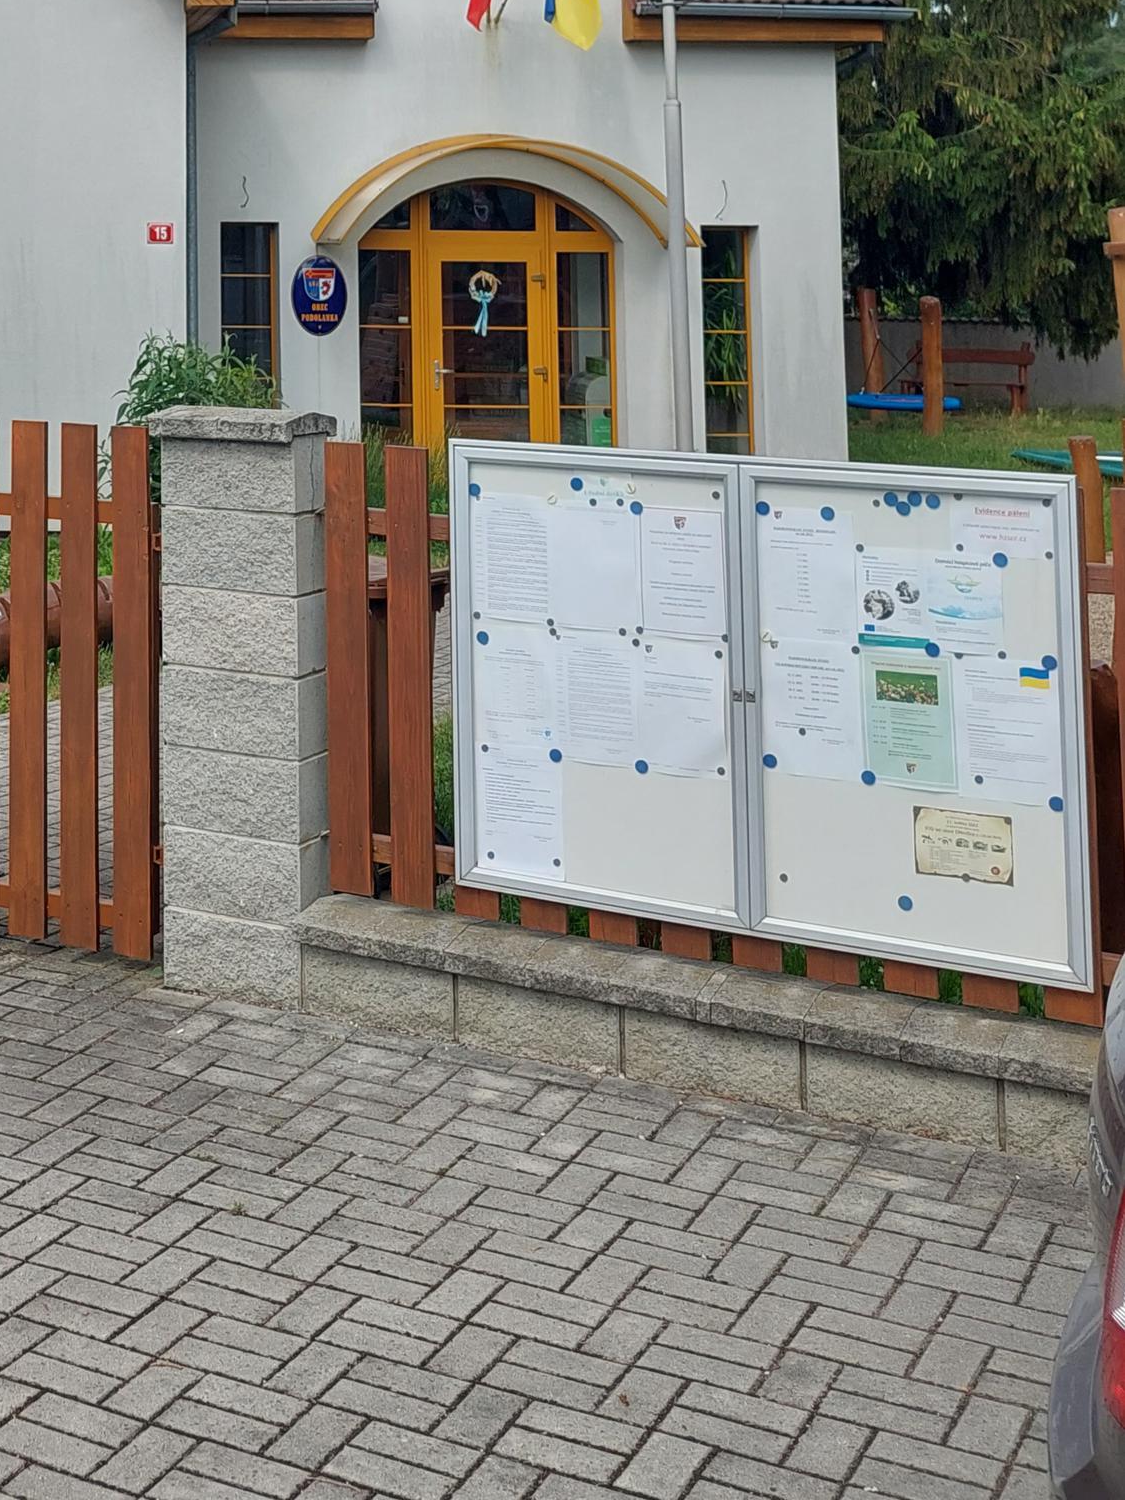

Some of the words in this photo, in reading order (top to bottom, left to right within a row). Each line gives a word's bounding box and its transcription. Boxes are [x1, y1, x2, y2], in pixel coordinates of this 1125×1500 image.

[154, 226, 168, 240] 15
[311, 303, 328, 311] OBEC
[301, 313, 338, 322] PODOLANKA
